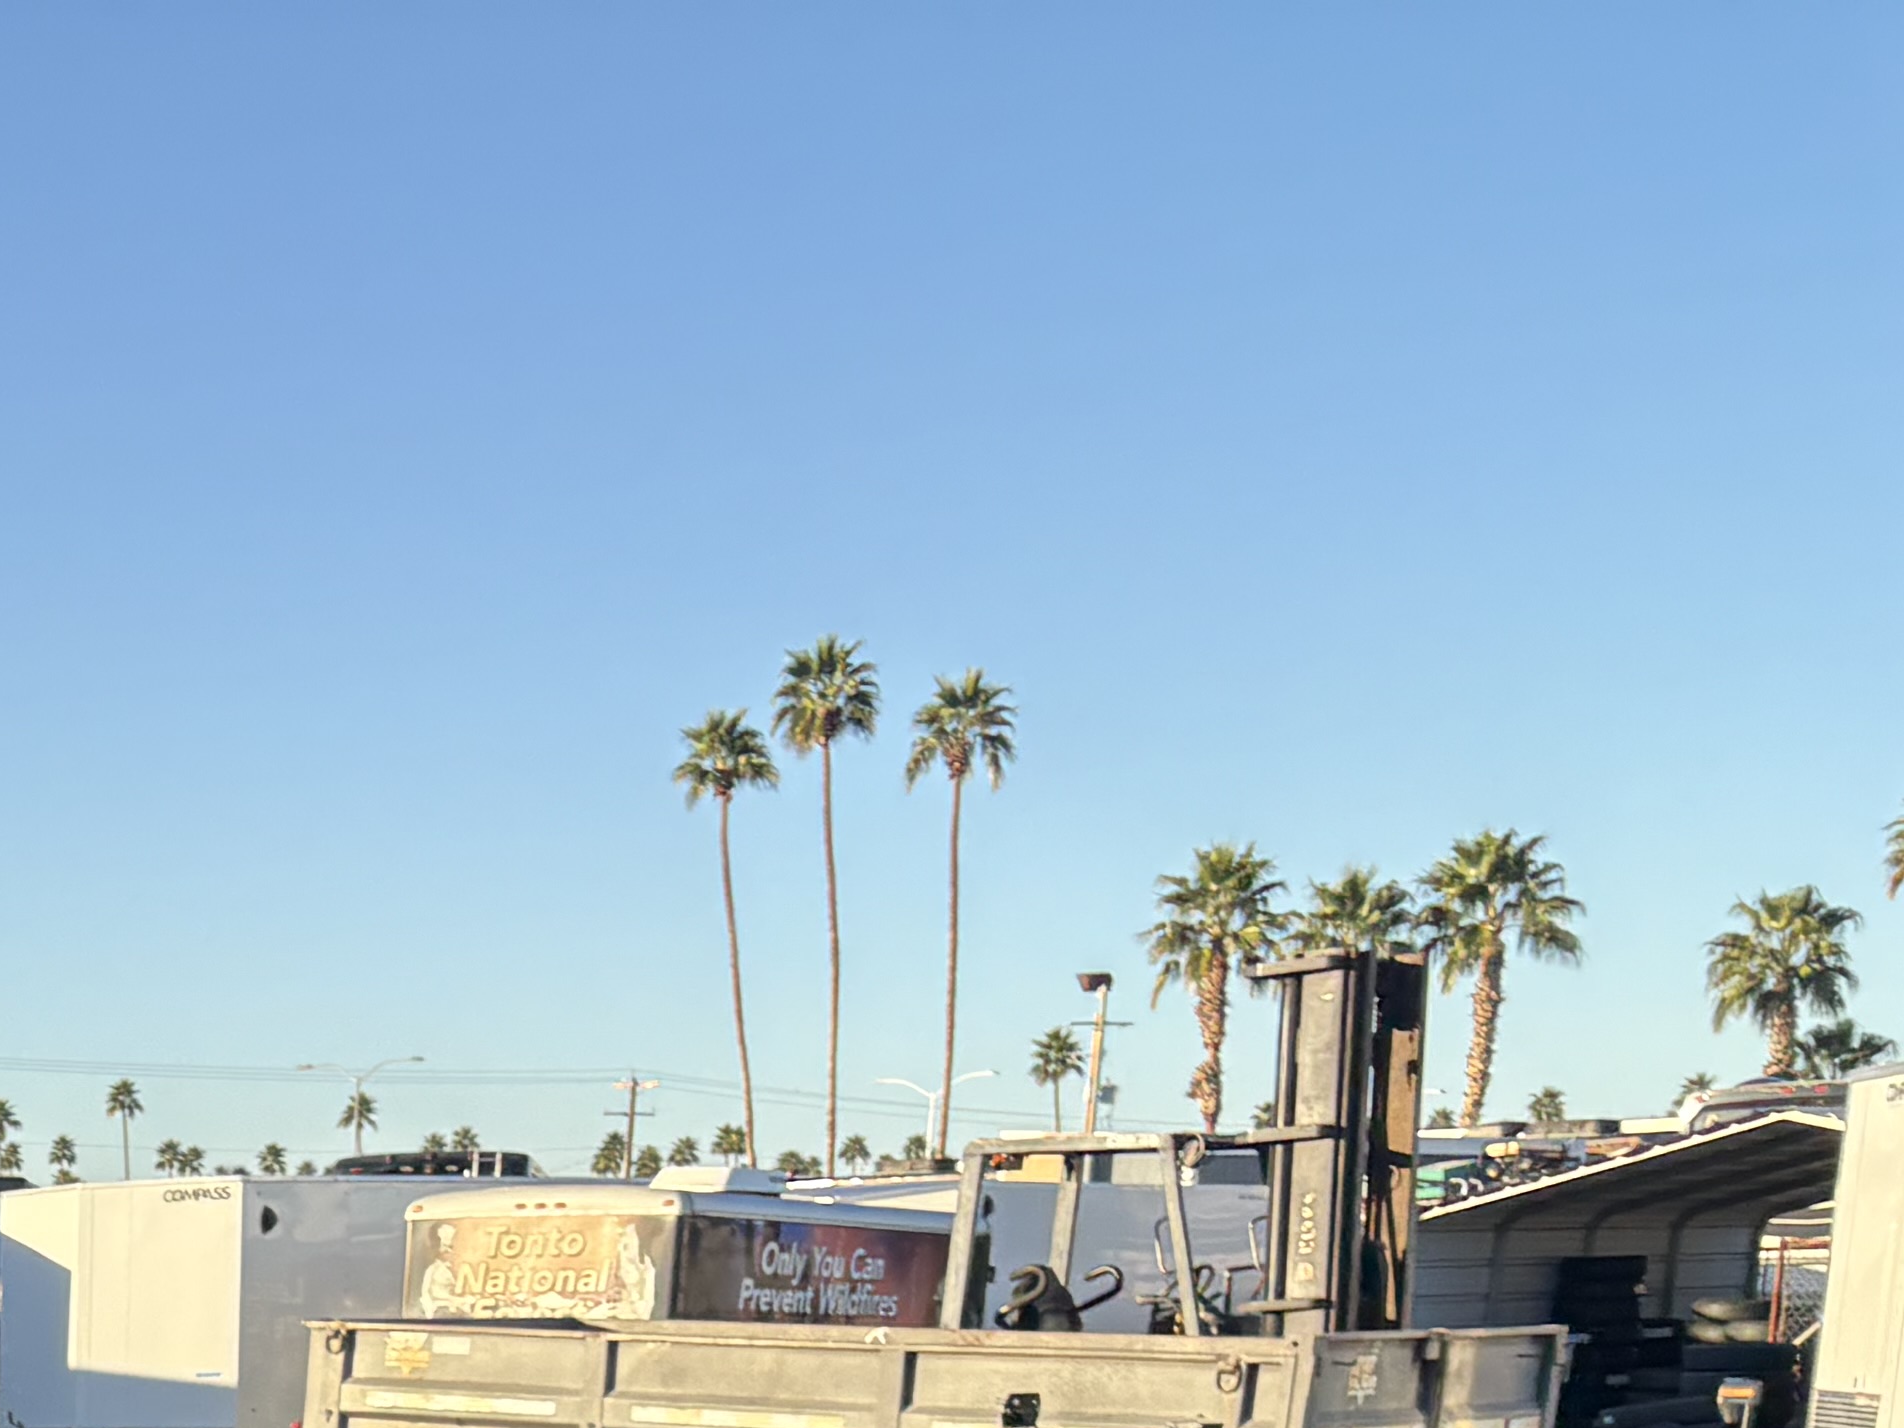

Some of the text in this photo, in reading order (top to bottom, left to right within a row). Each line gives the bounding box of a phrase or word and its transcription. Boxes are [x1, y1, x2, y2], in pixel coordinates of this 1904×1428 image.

[162, 1186, 231, 1202] COMPASS
[484, 1225, 585, 1259] Tonto
[454, 1258, 613, 1294] National
[762, 1241, 885, 1286] Only You Can
[739, 1277, 898, 1317] Prevent Wildfires
